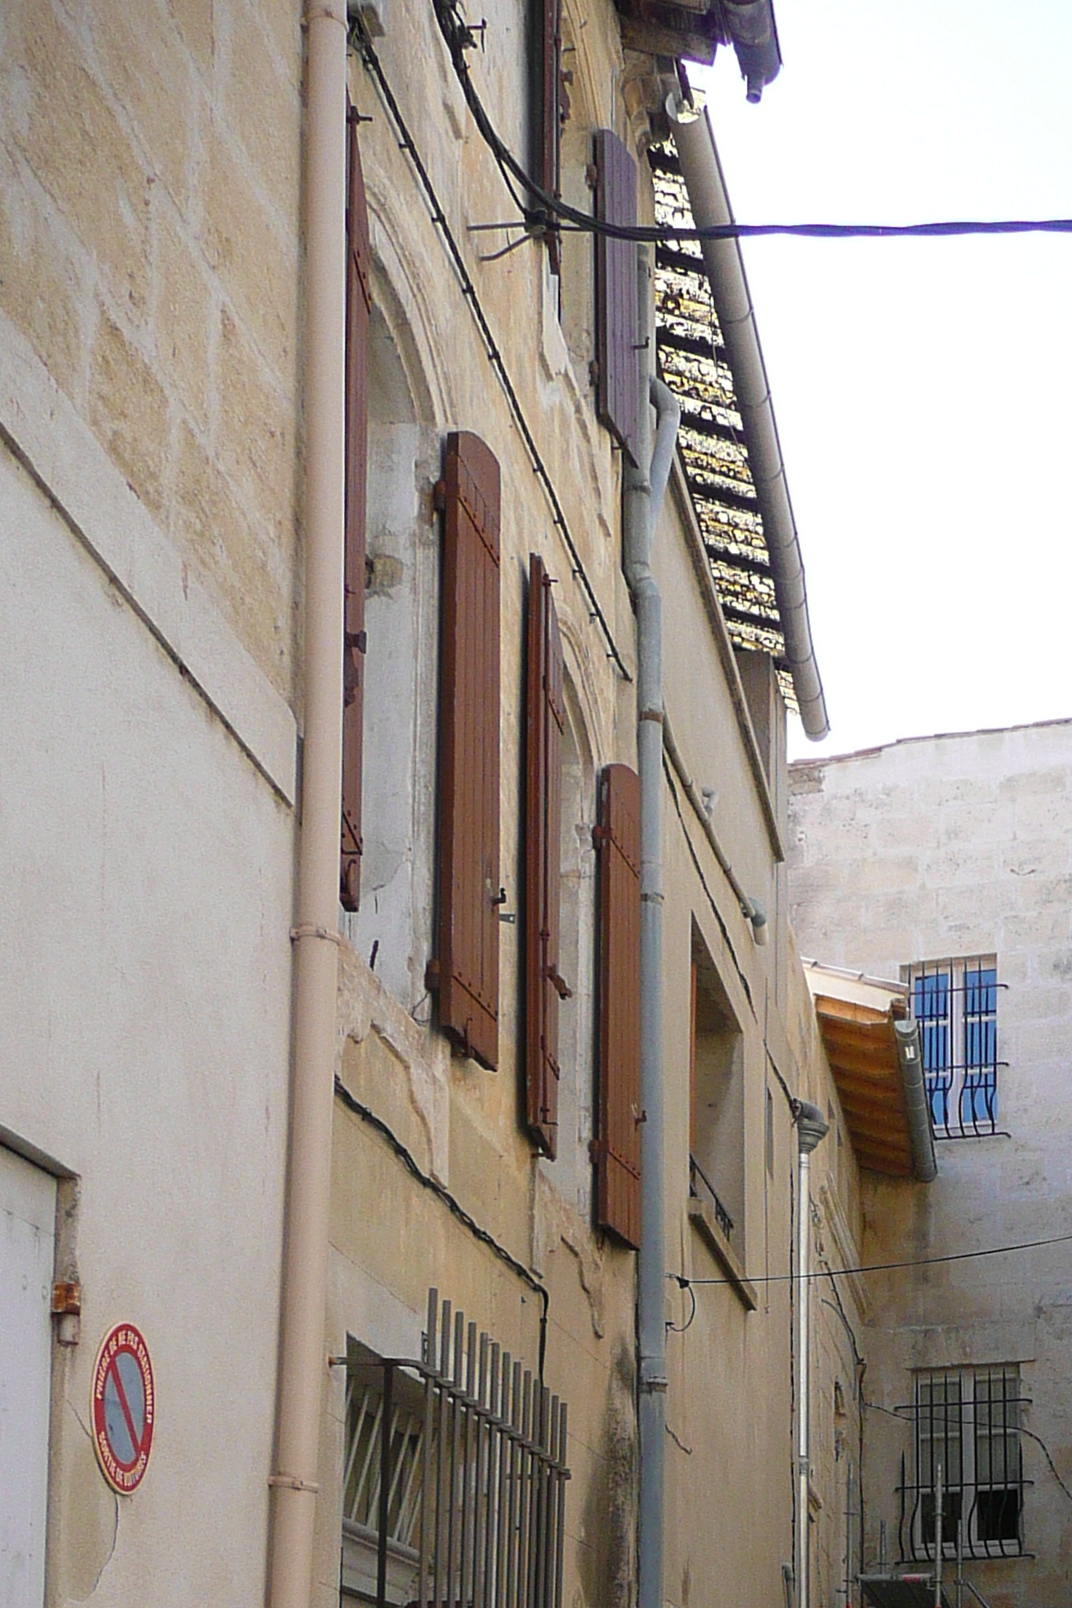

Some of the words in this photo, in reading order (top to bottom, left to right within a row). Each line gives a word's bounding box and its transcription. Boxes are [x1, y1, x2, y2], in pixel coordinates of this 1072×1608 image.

[109, 1336, 118, 1355] DE
[118, 1330, 126, 1346] NE
[127, 1330, 139, 1349] PAS
[137, 1343, 152, 1424] STATIONNER
[99, 1431, 116, 1477] SORTIE
[116, 1467, 124, 1485] DE
